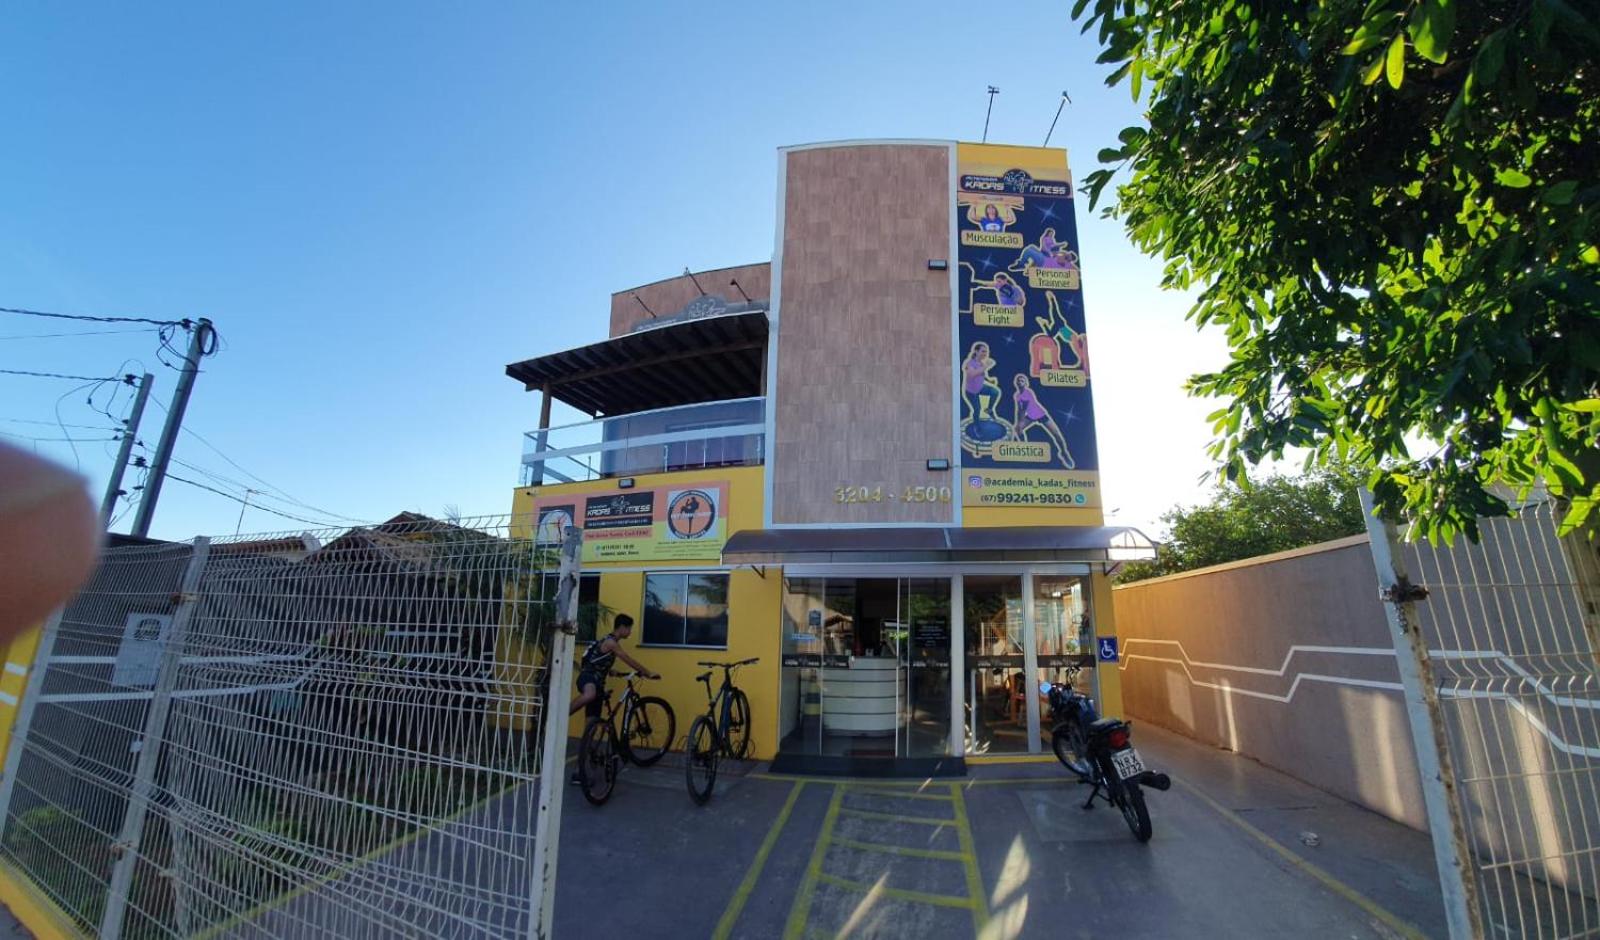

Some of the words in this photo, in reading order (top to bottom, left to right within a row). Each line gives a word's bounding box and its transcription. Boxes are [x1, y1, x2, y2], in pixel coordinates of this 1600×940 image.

[966, 232, 1019, 246] Musculação
[1036, 268, 1071, 278] Personal
[980, 304, 1017, 315] Personal
[988, 315, 1010, 325] Fight
[1047, 372, 1079, 384] Pilates
[999, 444, 1044, 457] Ginástica
[833, 486, 882, 504] 3204
[900, 486, 951, 504] 4500
